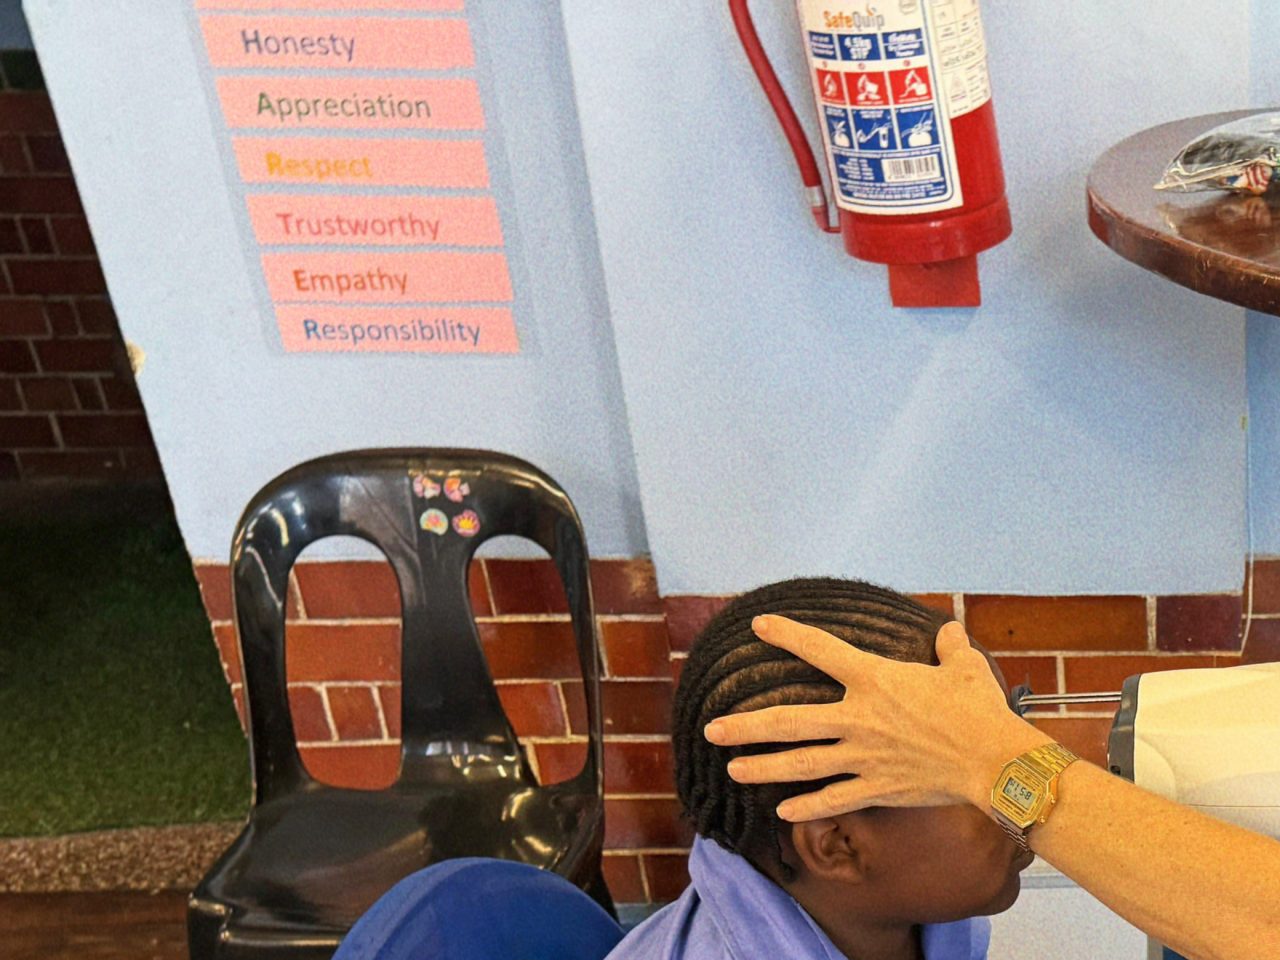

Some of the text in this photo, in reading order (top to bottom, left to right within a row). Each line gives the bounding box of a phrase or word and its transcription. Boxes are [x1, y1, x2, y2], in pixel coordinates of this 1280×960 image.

[241, 29, 356, 62] Honesty
[256, 91, 432, 122] Appreciation
[265, 151, 373, 181] Respect
[276, 211, 440, 241] Trustworthy
[292, 267, 408, 295] Empathy
[302, 318, 481, 346] Responsibility
